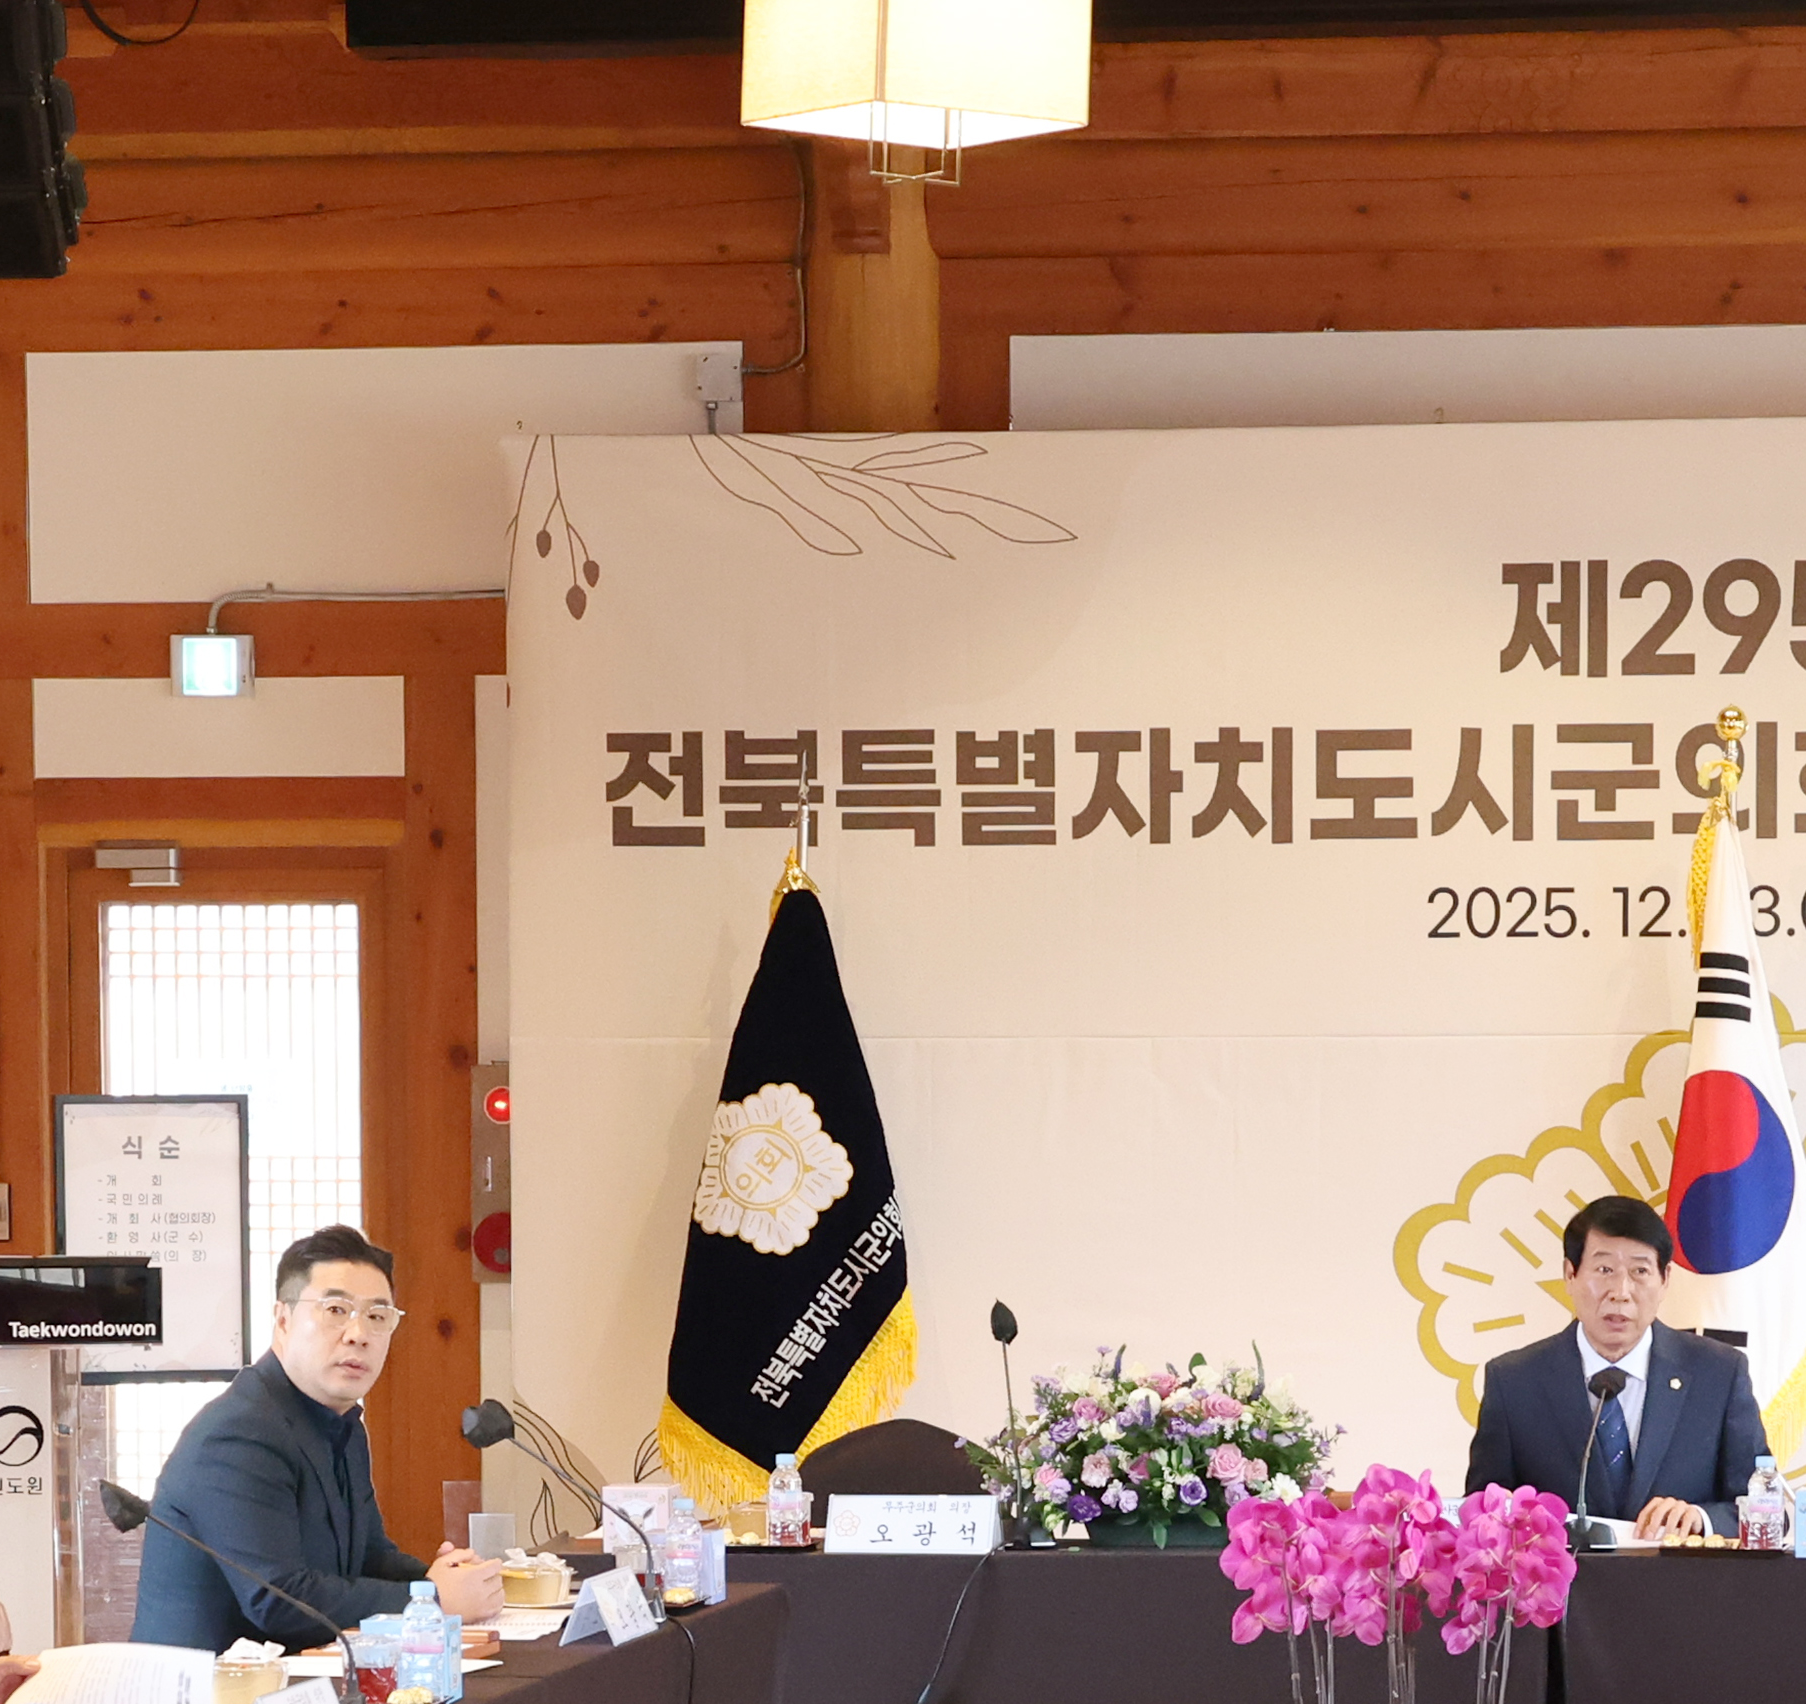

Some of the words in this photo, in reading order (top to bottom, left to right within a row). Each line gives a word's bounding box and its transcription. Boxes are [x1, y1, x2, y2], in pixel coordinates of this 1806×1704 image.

[1427, 886, 1590, 939] 2025.
[1612, 885, 1688, 938] 12.
[8, 1320, 157, 1338] Taekwondowon
